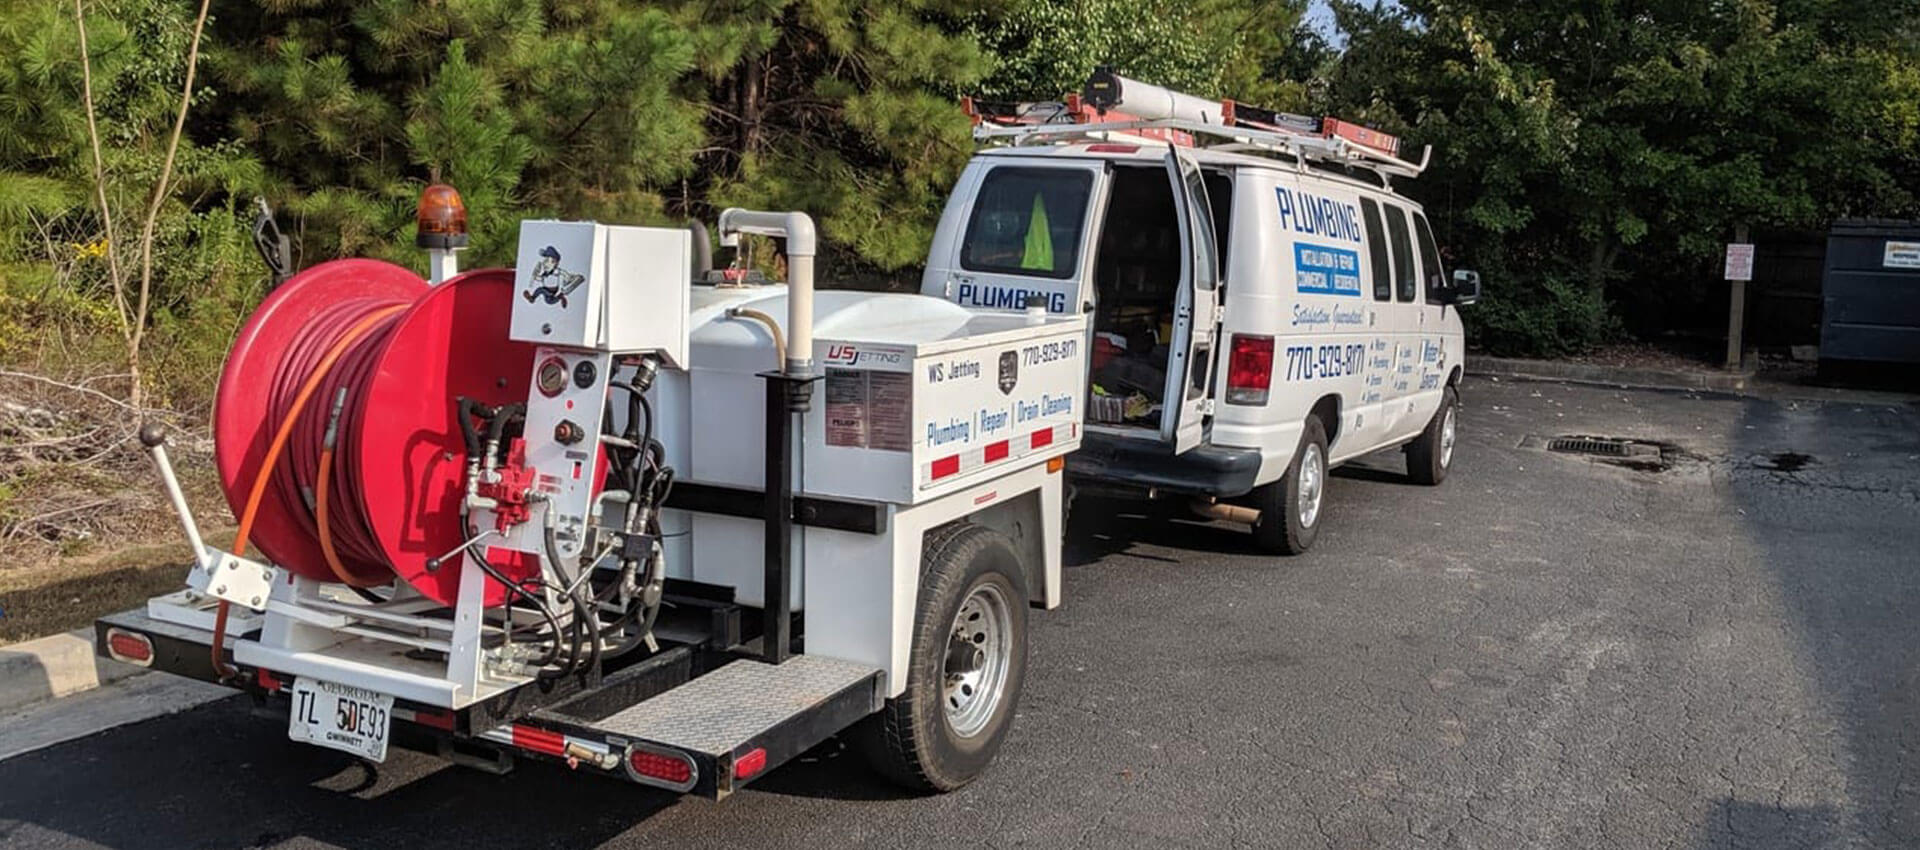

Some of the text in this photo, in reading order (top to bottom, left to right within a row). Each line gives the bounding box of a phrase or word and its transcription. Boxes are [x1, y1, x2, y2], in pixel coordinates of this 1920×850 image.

[1275, 187, 1361, 243] PLUMBING
[959, 283, 1065, 313] PLUMBNG
[928, 363, 944, 383] WS
[948, 360, 980, 380] Jetting
[1022, 340, 1077, 367] 770-929-8171
[1286, 344, 1366, 381] 770-929-8171
[927, 418, 969, 447] Plumbing
[980, 409, 1008, 435] Repair
[1018, 400, 1039, 423] Drain
[1041, 394, 1072, 416] Cleaning
[298, 690, 385, 741] TL 5DE93
